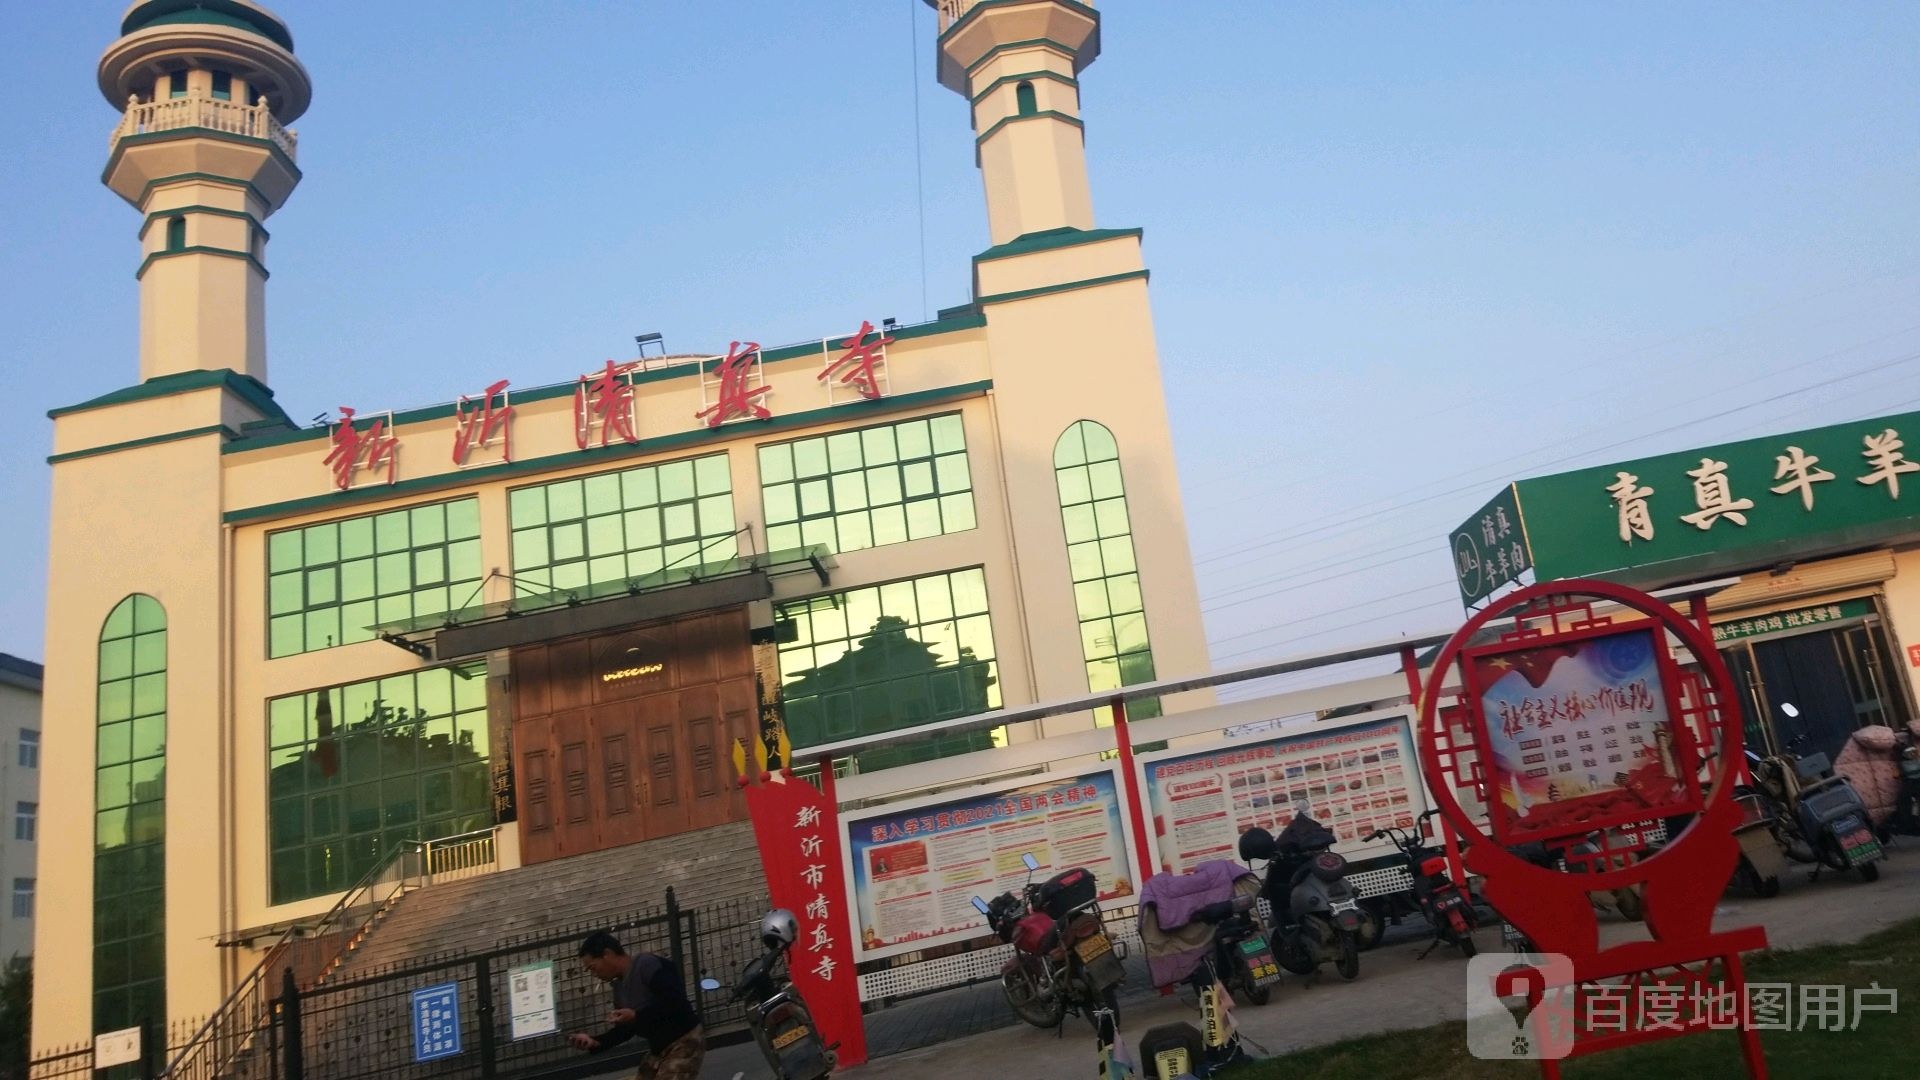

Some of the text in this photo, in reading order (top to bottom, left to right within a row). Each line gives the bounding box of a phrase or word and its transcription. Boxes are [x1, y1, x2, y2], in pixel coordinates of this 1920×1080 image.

[322, 319, 895, 491] 新沂清真寺
[1481, 506, 1511, 547] 清真
[1485, 541, 1525, 588] 牛羊肉
[871, 783, 1097, 843] 深入学习贯彻2021全国两会精神
